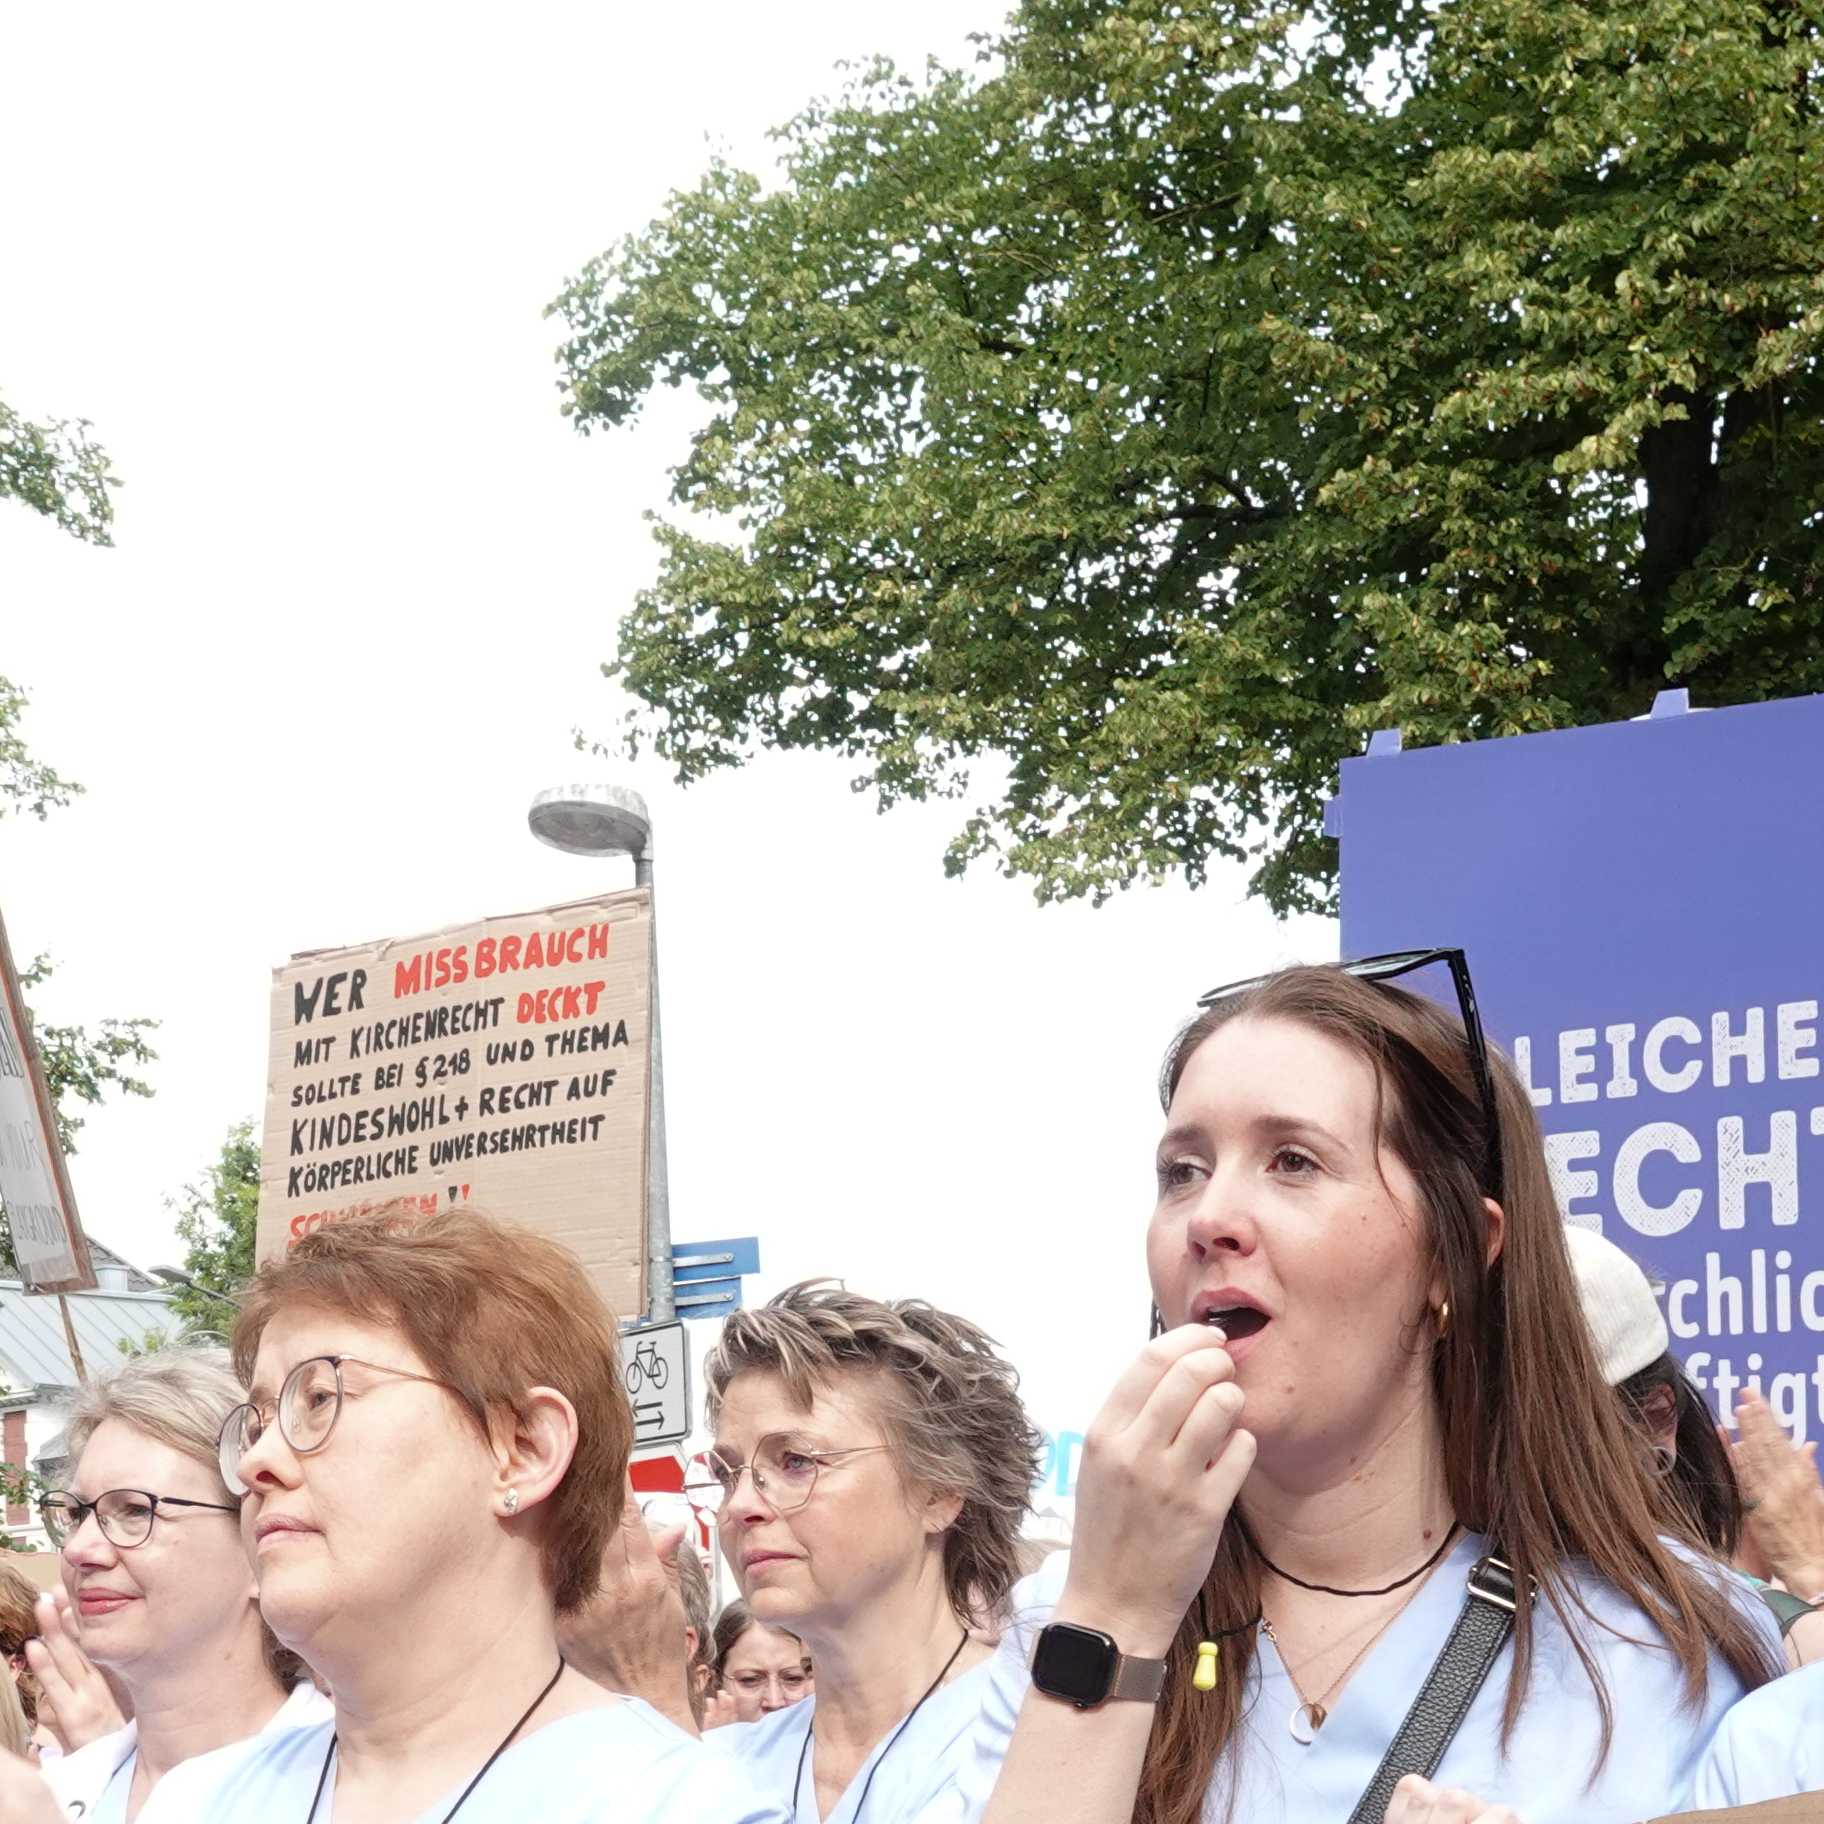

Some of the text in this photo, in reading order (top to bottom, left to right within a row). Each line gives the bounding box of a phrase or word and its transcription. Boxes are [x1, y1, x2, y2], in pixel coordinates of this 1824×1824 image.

[293, 968, 367, 1026] WER
[293, 980, 606, 1069] MIT KIRCHENRECHT DECKT
[290, 1072, 362, 1108] SOLLTE
[374, 1063, 403, 1091] BEI
[486, 1038, 534, 1066] UND
[545, 1019, 630, 1059] THEMA
[479, 1079, 560, 1118] RECHT
[566, 1069, 618, 1102] AUF
[287, 1113, 606, 1199] KÖRPERLICHE UNVERSEHRTHEIT
